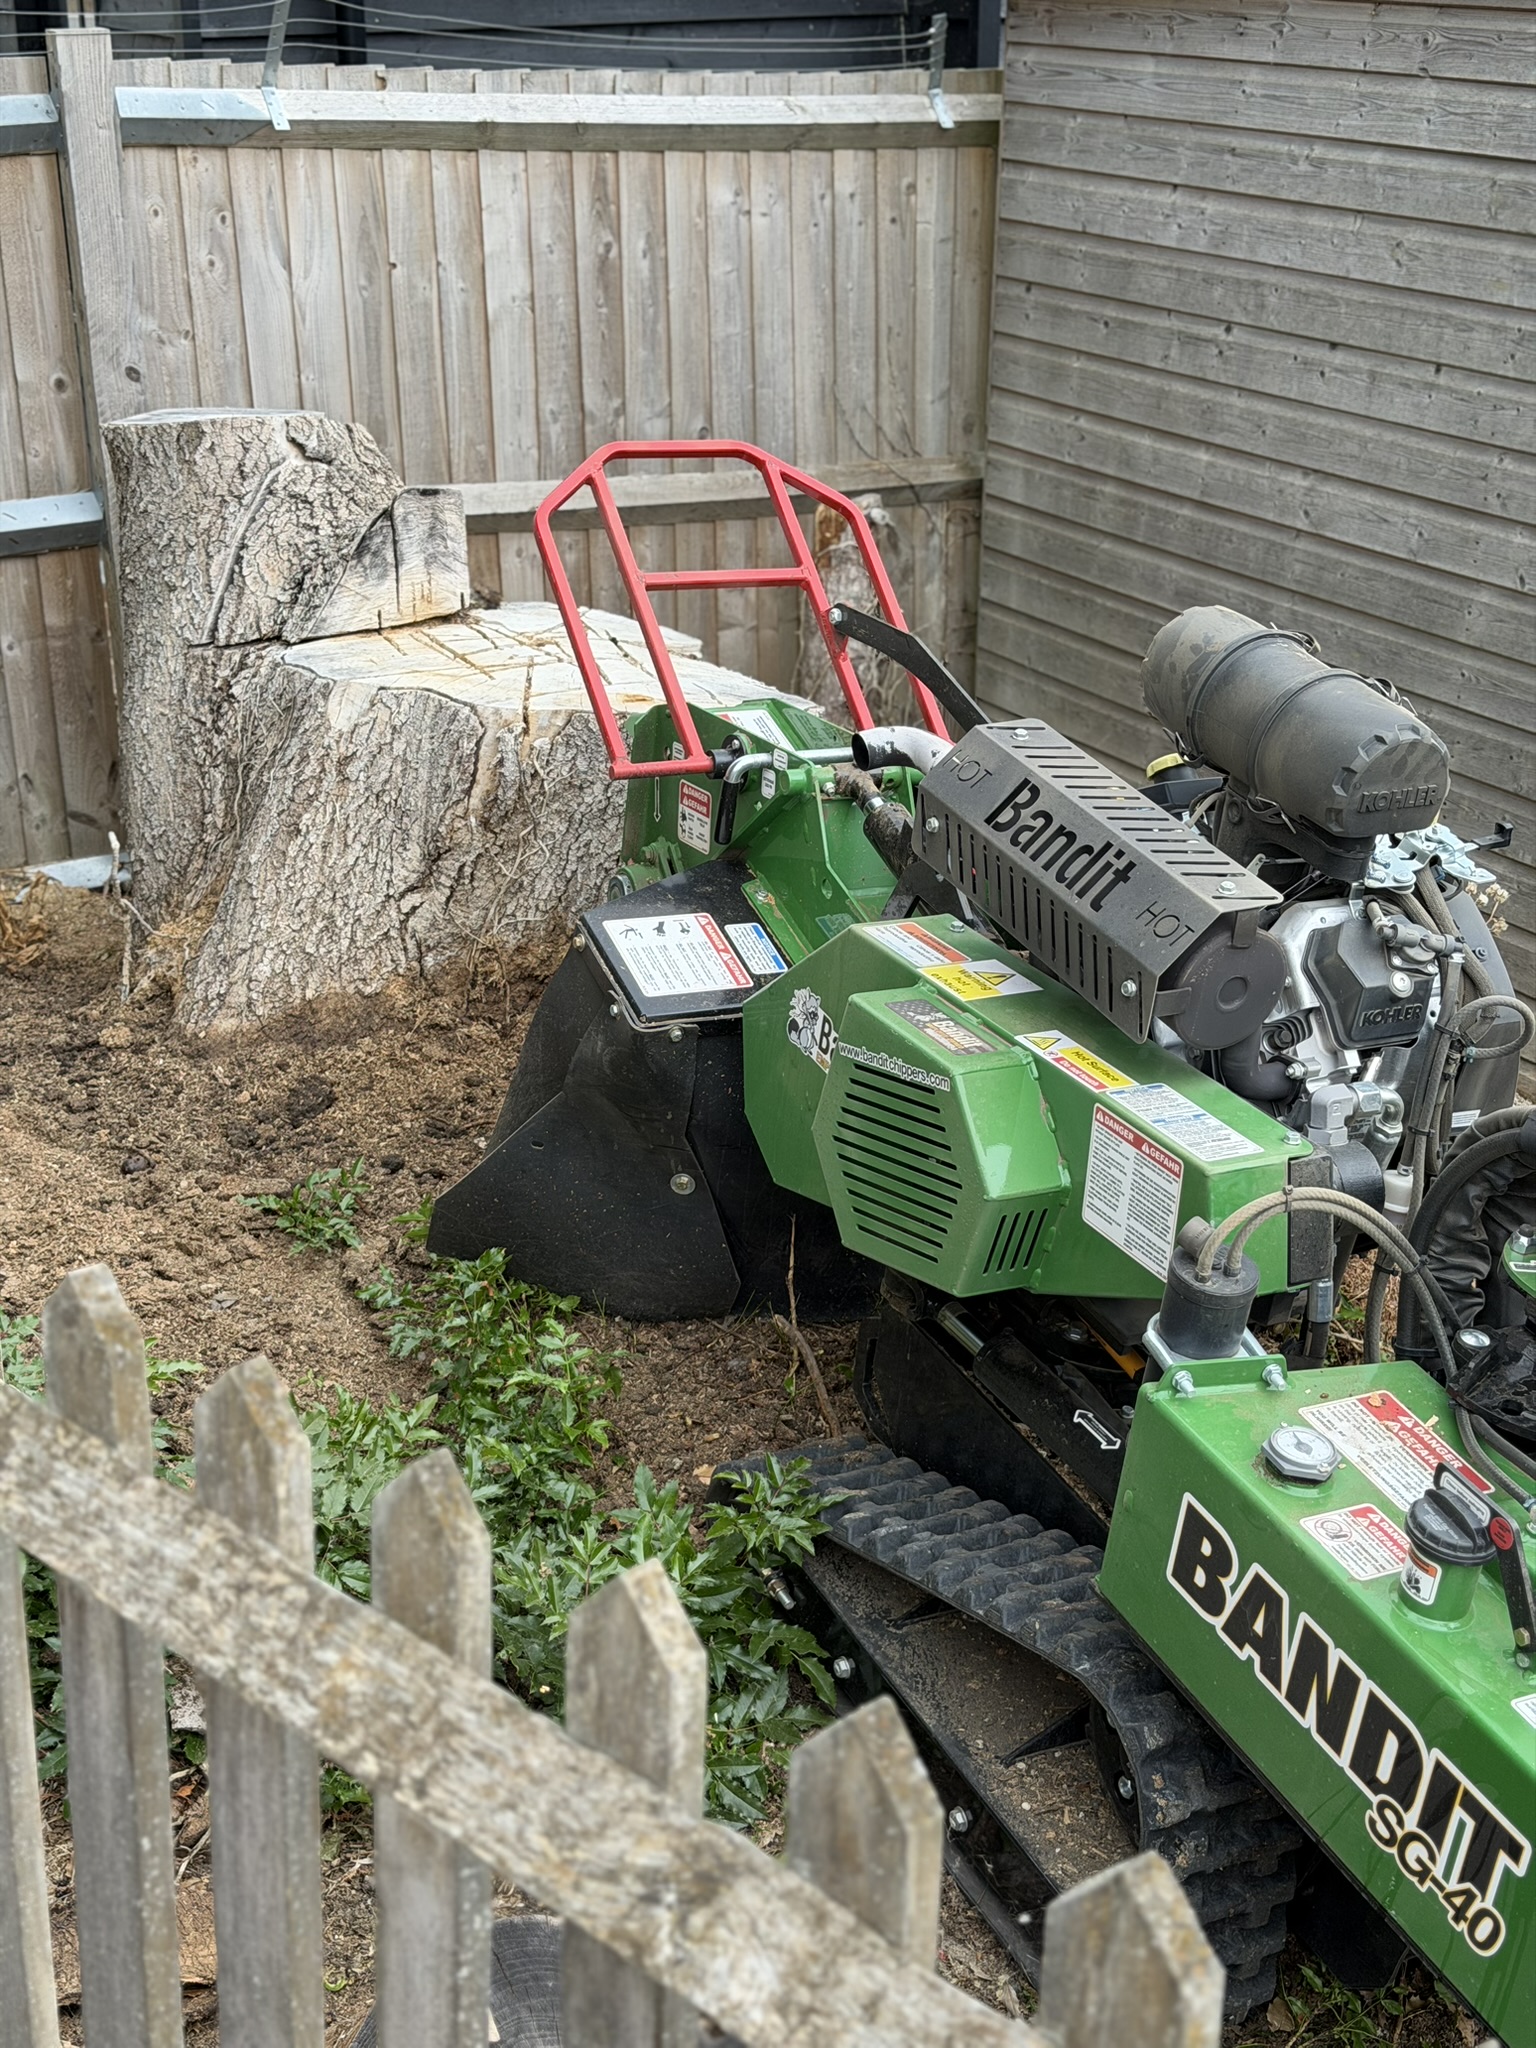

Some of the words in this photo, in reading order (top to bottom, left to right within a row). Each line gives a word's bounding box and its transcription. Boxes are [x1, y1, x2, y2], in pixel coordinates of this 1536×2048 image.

[943, 751, 993, 789] HOT
[688, 784, 708, 804] DANGER
[688, 799, 707, 815] GEFAHR
[1358, 784, 1440, 813] KOHLER
[983, 777, 1137, 912] Bandit
[1135, 901, 1195, 947] HOT
[705, 924, 726, 951] DANGER
[727, 956, 747, 985] GEFAHR
[932, 1020, 983, 1048] Bandit
[1360, 1004, 1424, 1027] KOHLER
[839, 1043, 950, 1090] www.banditchippers.com
[1071, 1051, 1089, 1063] Hot
[1087, 1061, 1119, 1082] Surface
[1104, 1114, 1134, 1142] DANGER
[1150, 1147, 1180, 1174] GEFAHR
[1413, 1426, 1463, 1468] DANGER
[1368, 1525, 1406, 1559] GEFAHR
[1169, 1497, 1529, 1904] BANDIT
[1369, 1798, 1502, 1951] SG-40
